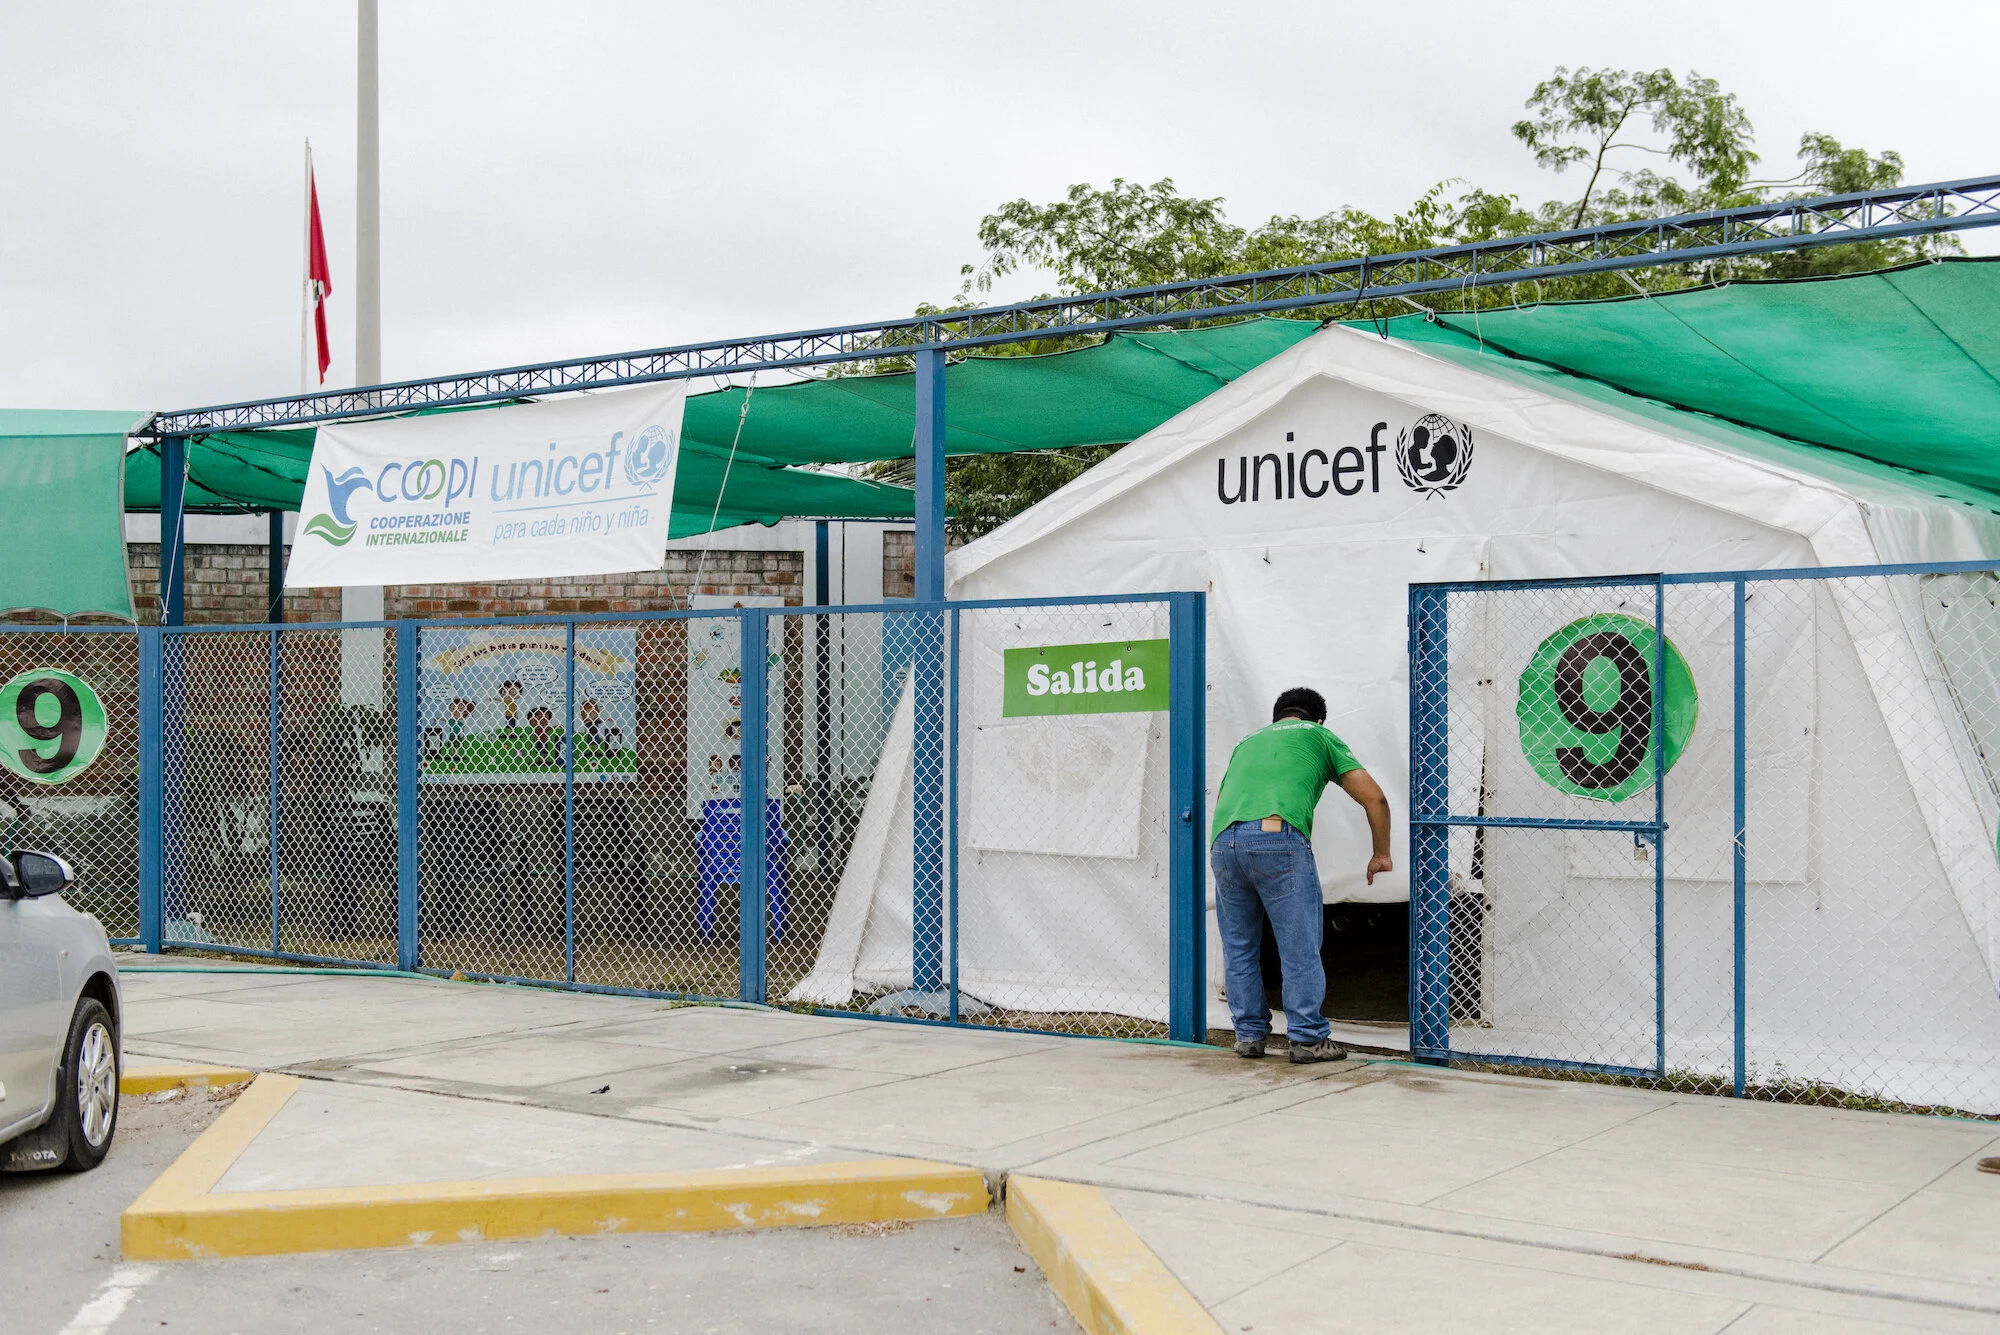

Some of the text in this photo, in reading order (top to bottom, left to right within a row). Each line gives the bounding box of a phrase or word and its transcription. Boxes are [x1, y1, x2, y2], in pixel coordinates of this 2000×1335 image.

[376, 456, 478, 508] COOPI
[490, 431, 624, 502] unicef
[1217, 421, 1387, 505] unicef
[365, 528, 469, 547] INTERNAZIONALE
[370, 511, 471, 530] COOPERAZIONE
[492, 504, 650, 546] para cada niño y niña
[1026, 659, 1146, 696] Salida
[16, 678, 83, 774] 9
[1554, 632, 1653, 789] 9
[11, 1150, 57, 1161] TOYOTA
